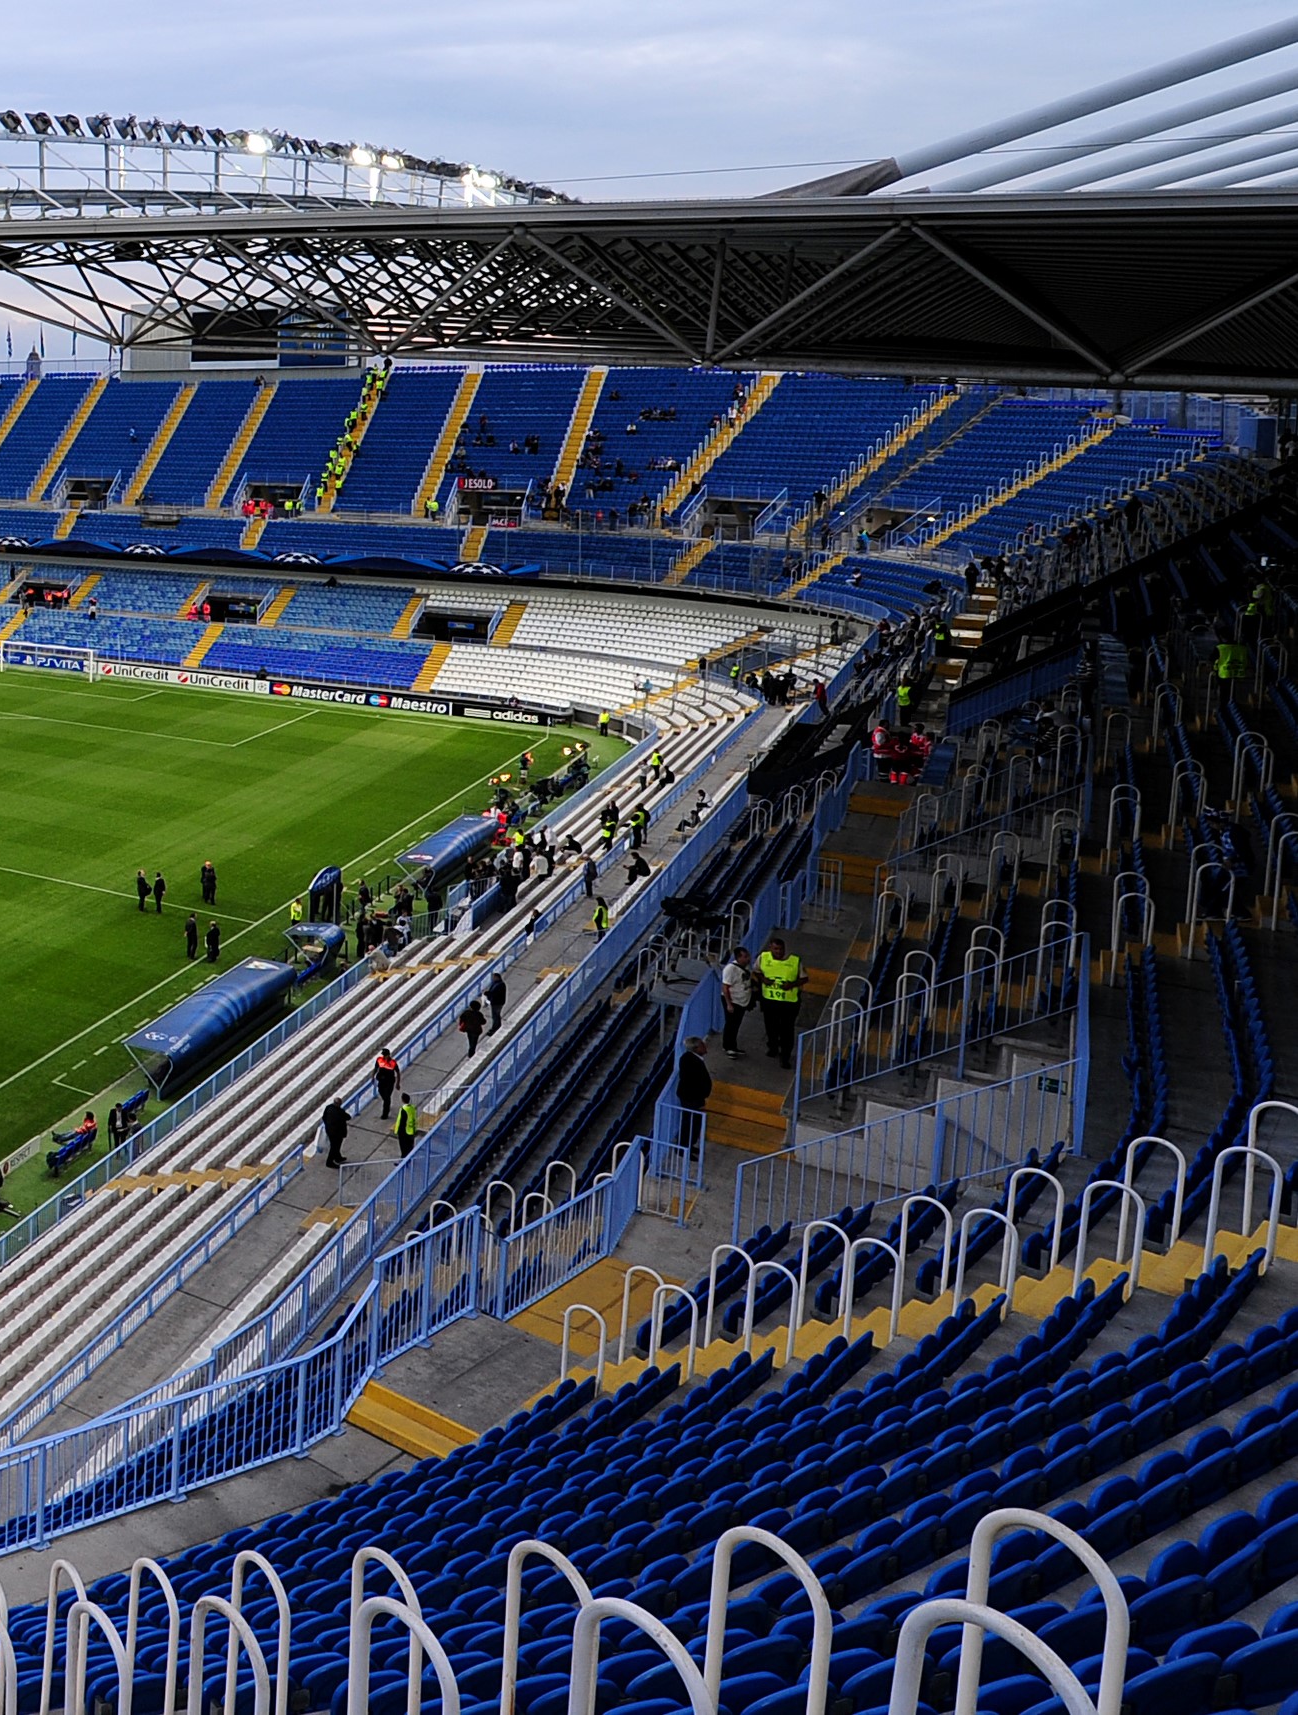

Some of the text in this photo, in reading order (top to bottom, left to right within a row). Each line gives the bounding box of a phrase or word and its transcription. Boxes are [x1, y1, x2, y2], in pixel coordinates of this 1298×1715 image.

[463, 478, 493, 489] JESOLO
[112, 663, 170, 682] UniCredit
[189, 674, 250, 692] UniCredit
[291, 684, 366, 705] MasterCard
[390, 696, 447, 714] Maestro
[492, 709, 539, 724] adidas
